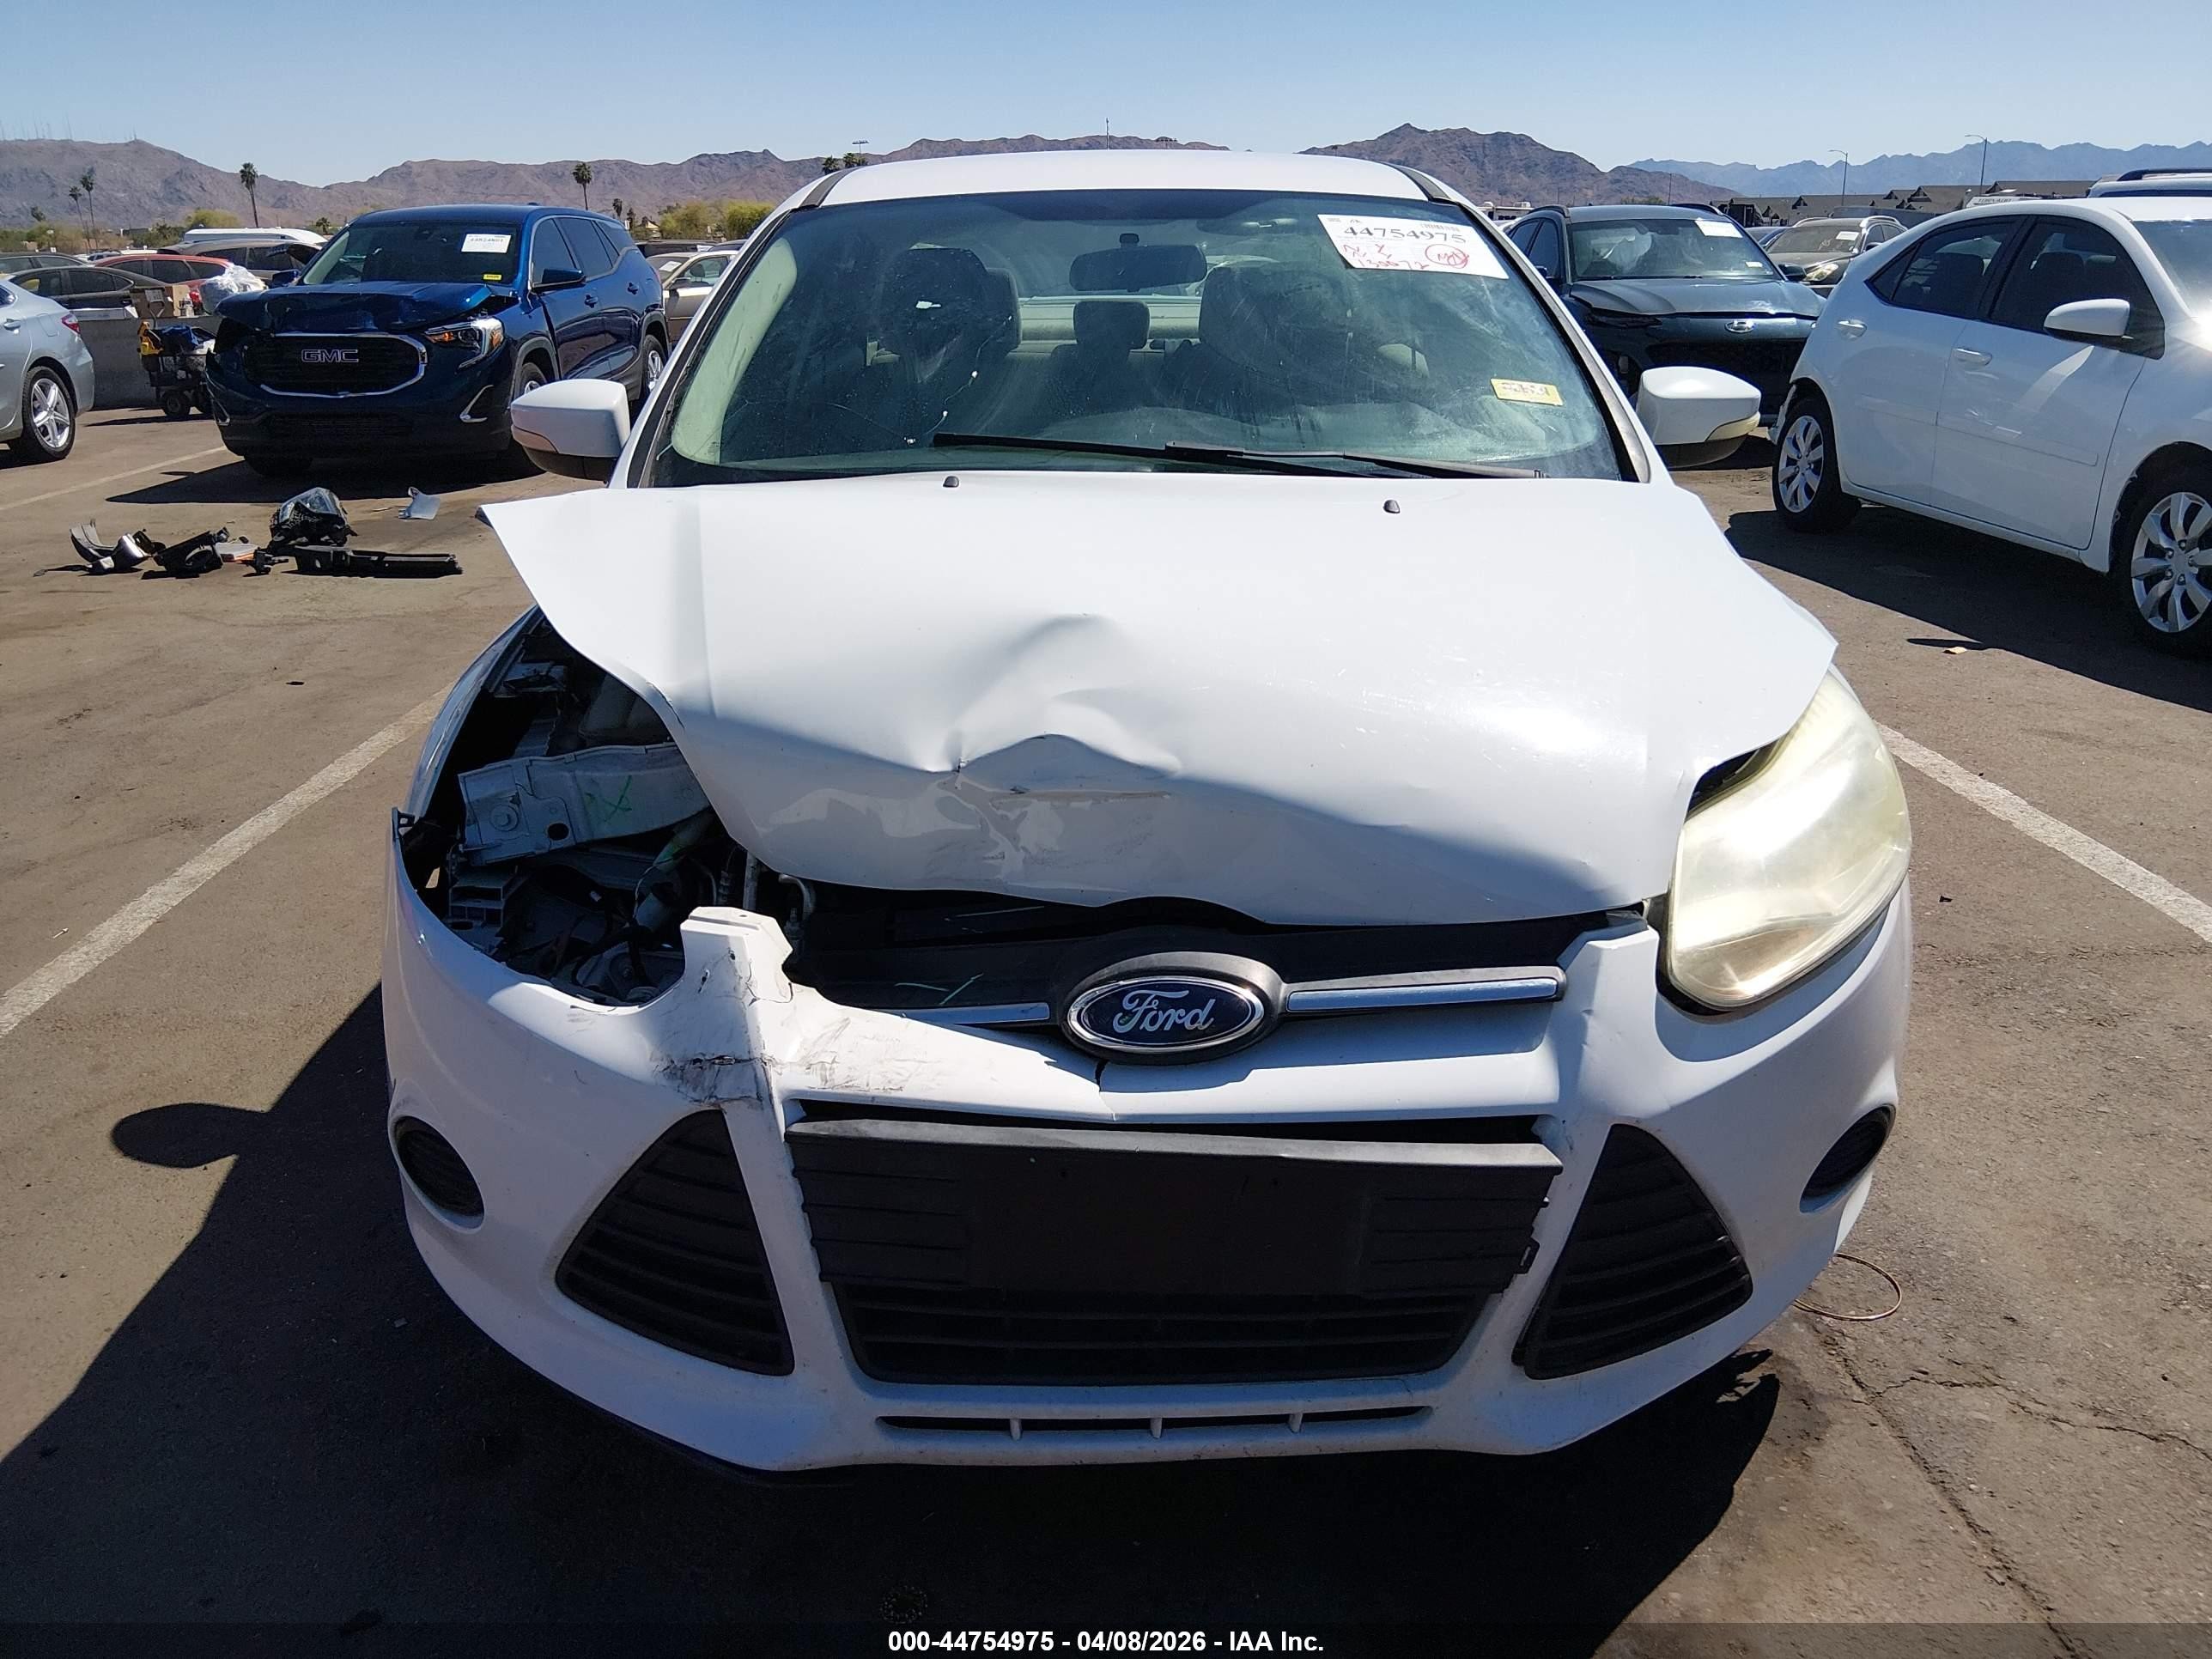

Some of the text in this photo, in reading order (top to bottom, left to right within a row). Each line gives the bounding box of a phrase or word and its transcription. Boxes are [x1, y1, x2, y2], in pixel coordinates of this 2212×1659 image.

[1344, 226, 1467, 243] 44754975
[301, 349, 359, 362] GMC
[1113, 989, 1216, 1033] Ford
